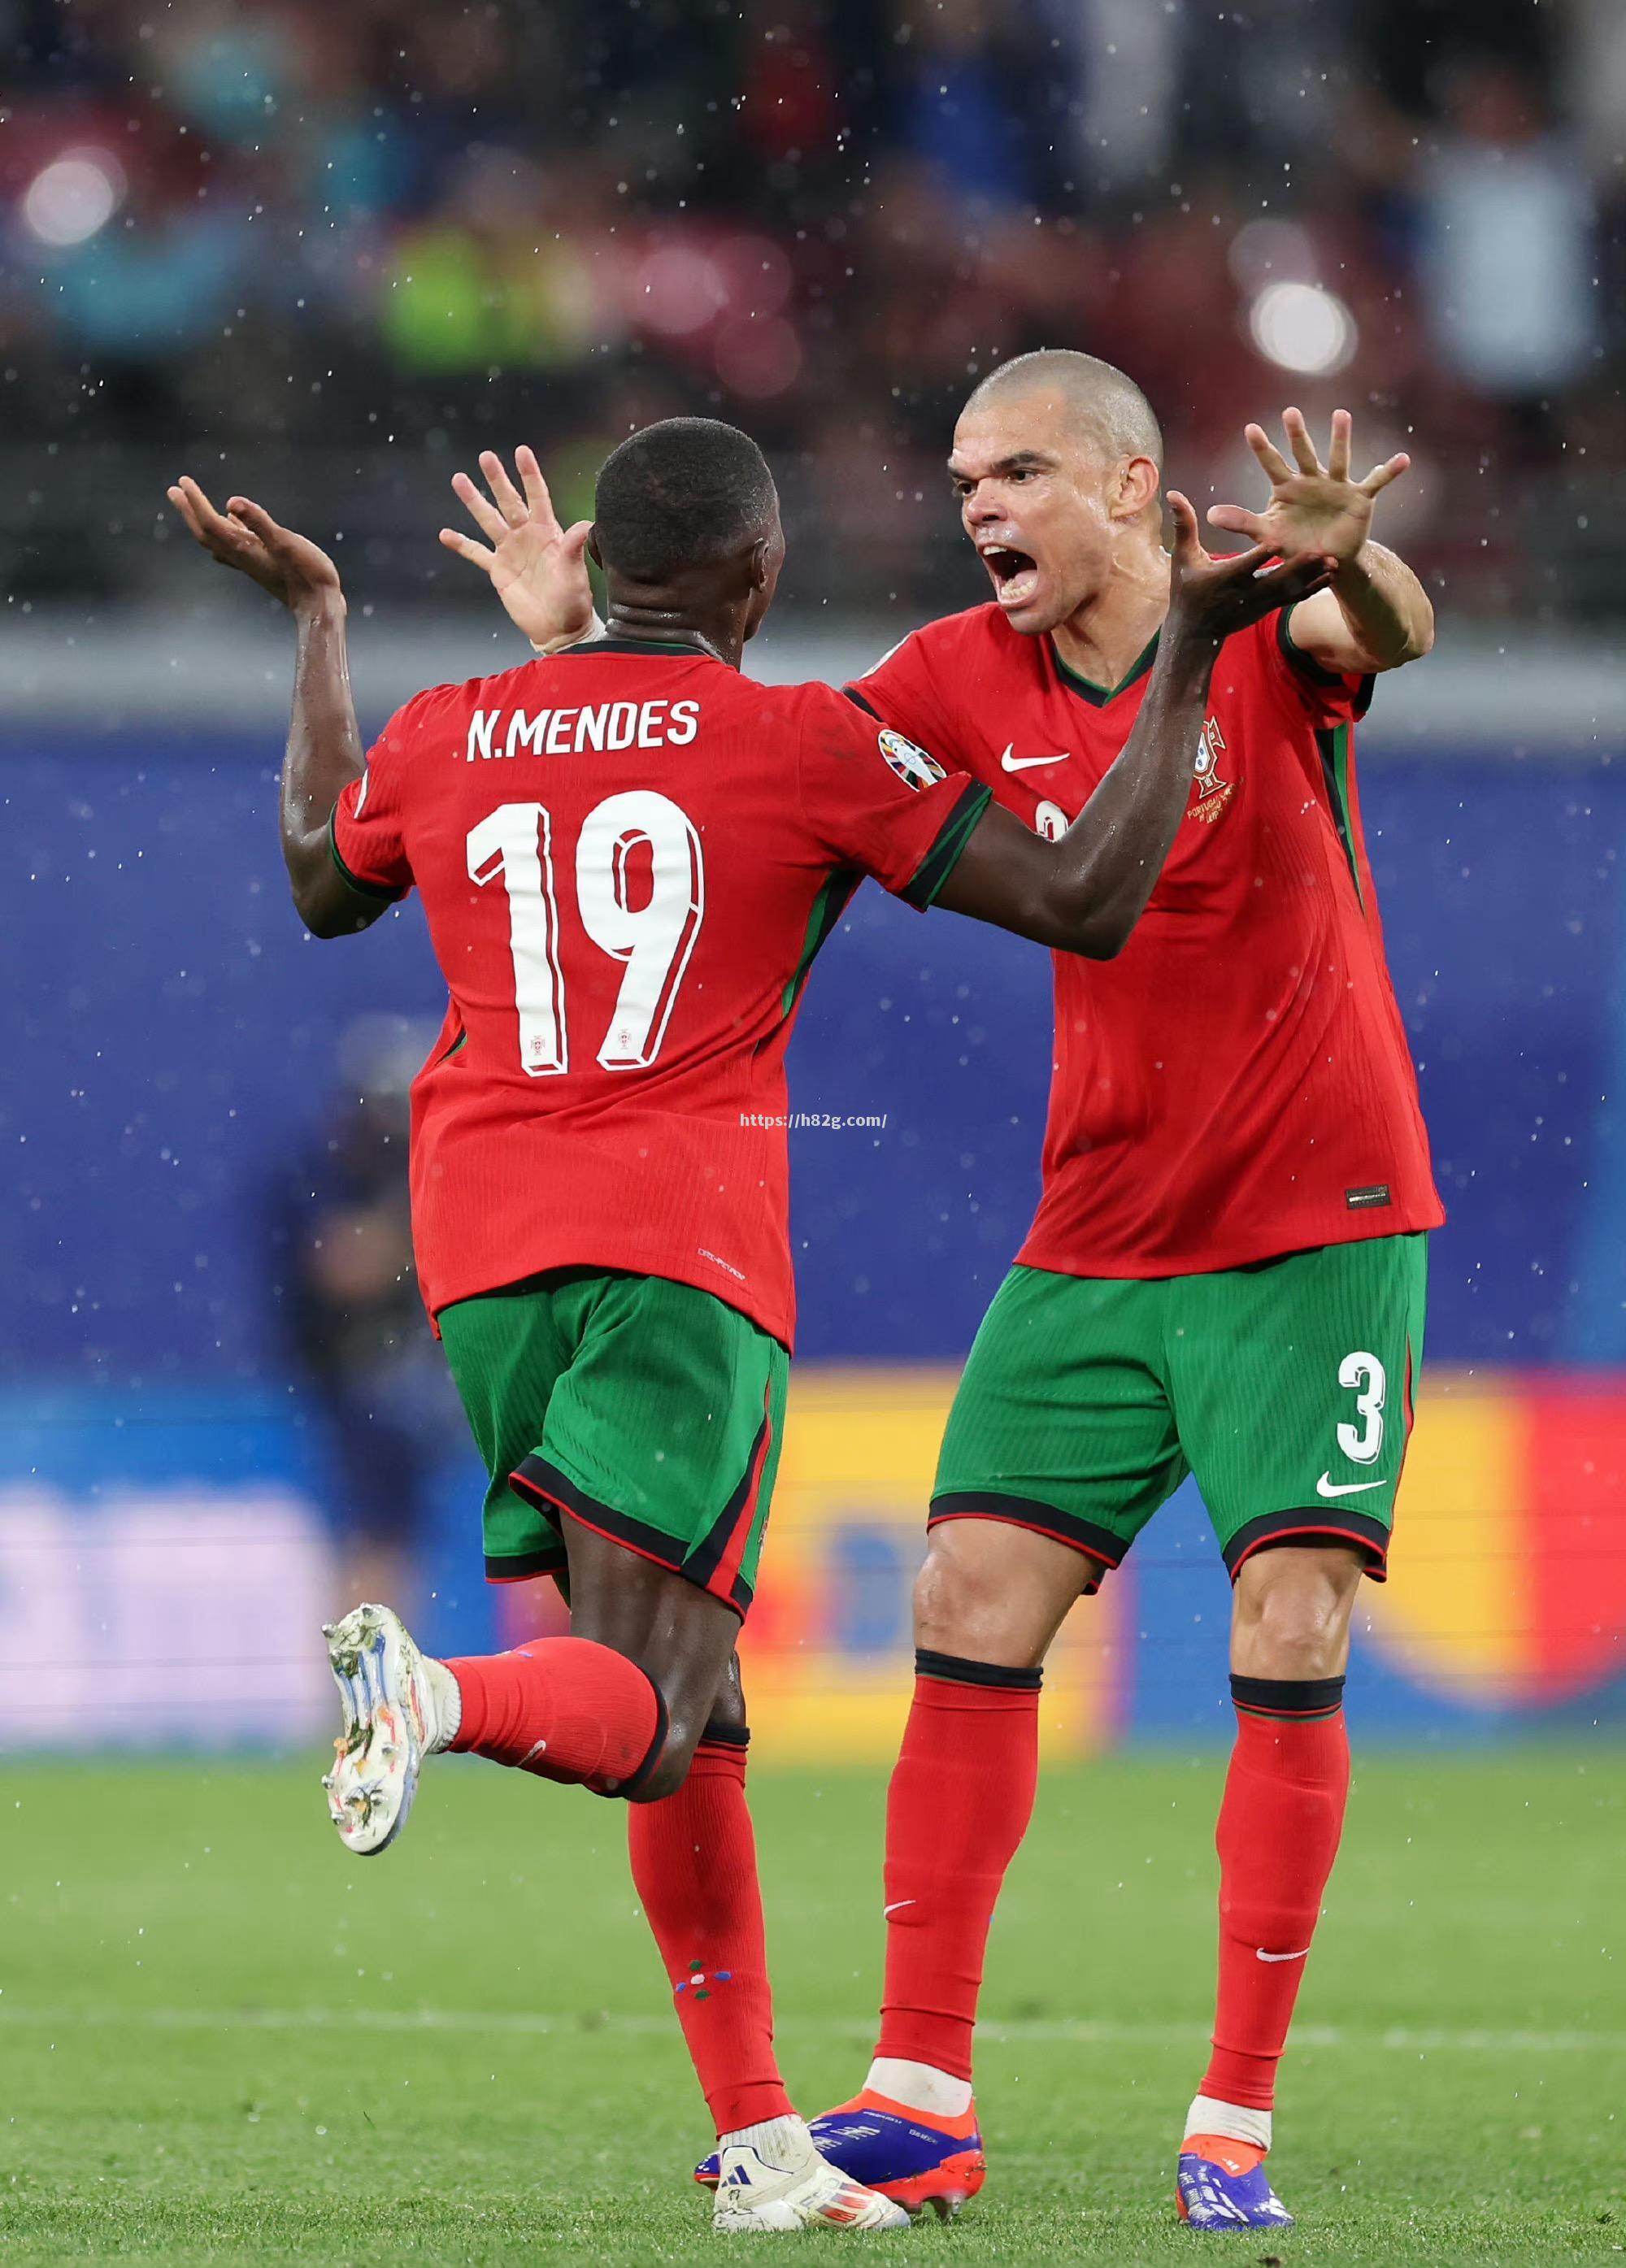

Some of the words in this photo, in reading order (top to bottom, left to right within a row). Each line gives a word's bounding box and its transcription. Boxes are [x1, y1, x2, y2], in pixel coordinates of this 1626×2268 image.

[466, 699, 700, 763] N.MENDES
[466, 789, 706, 1078] 19
[1337, 1350, 1387, 1466] 3
